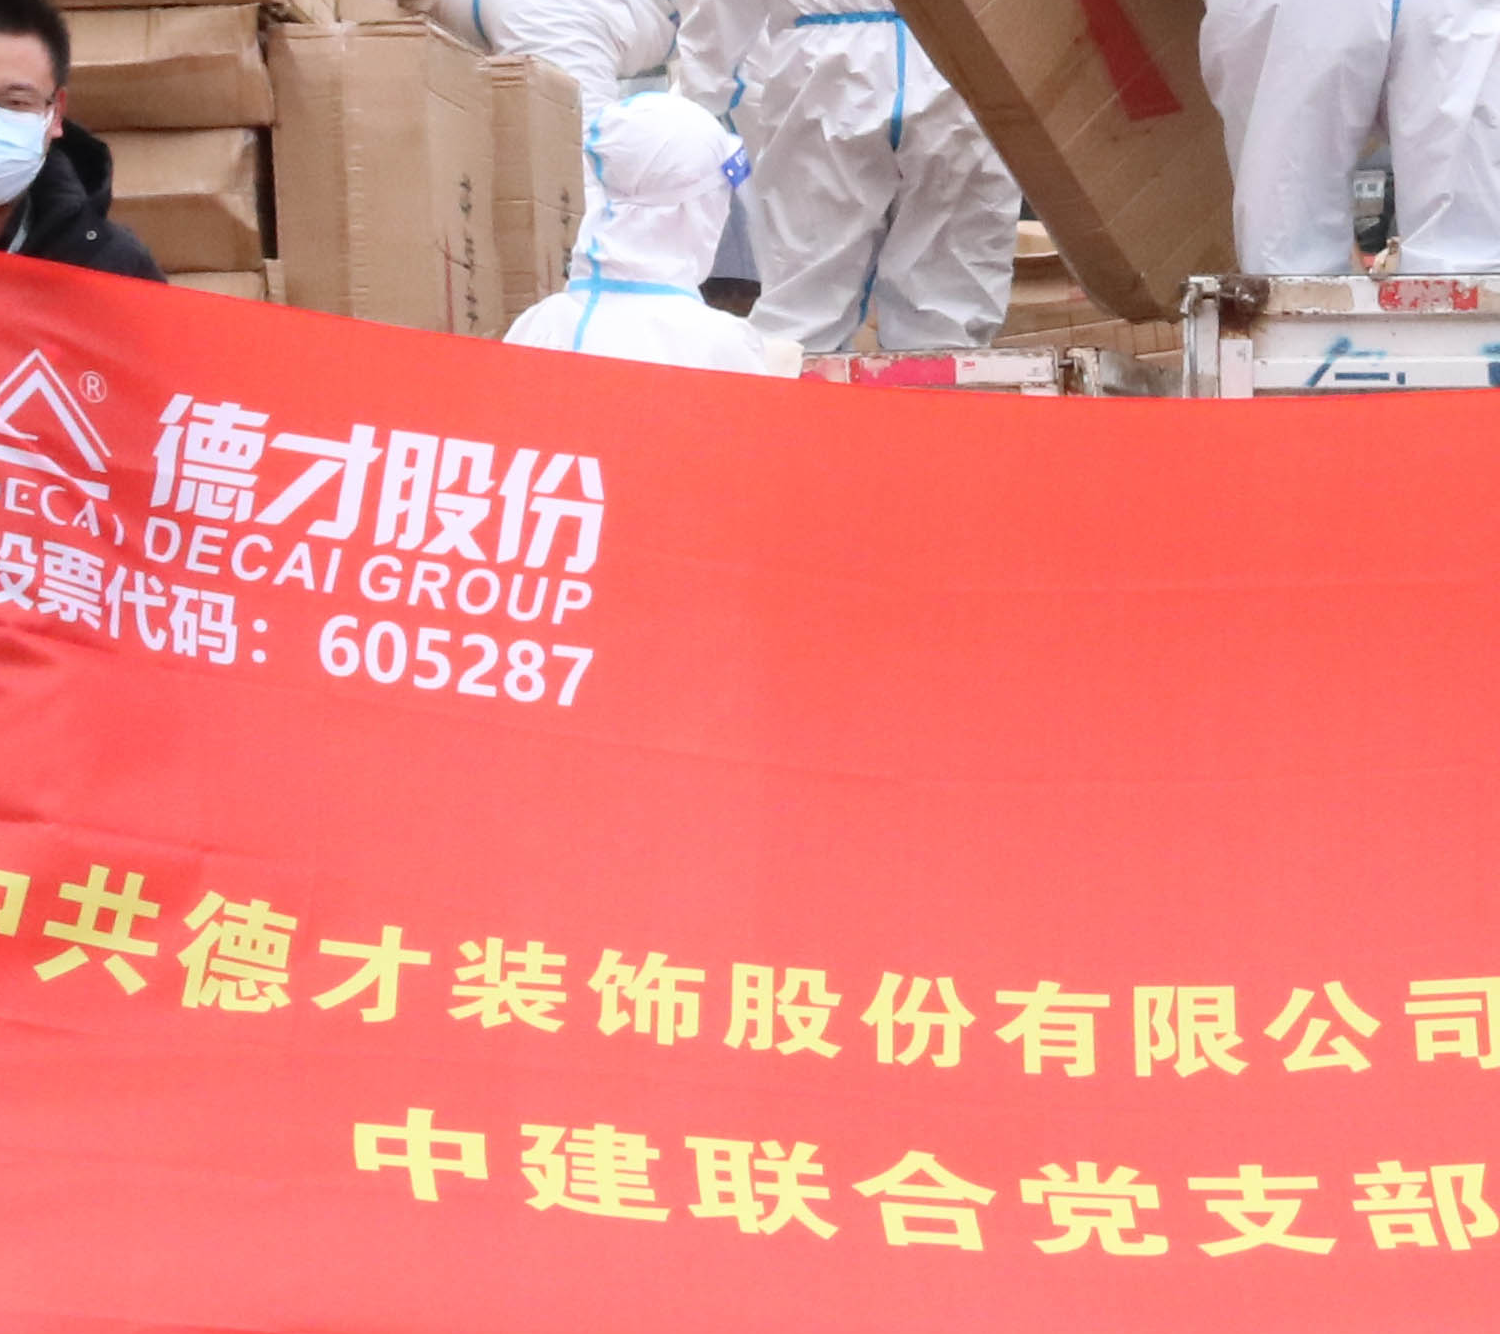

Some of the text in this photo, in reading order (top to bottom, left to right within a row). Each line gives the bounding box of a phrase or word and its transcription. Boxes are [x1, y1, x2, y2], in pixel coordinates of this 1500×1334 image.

[151, 393, 605, 575] 德才股份
[144, 517, 594, 625] DECAI GROUP
[319, 614, 594, 707] 605287
[352, 1107, 1500, 1257] 中建联合党支部
